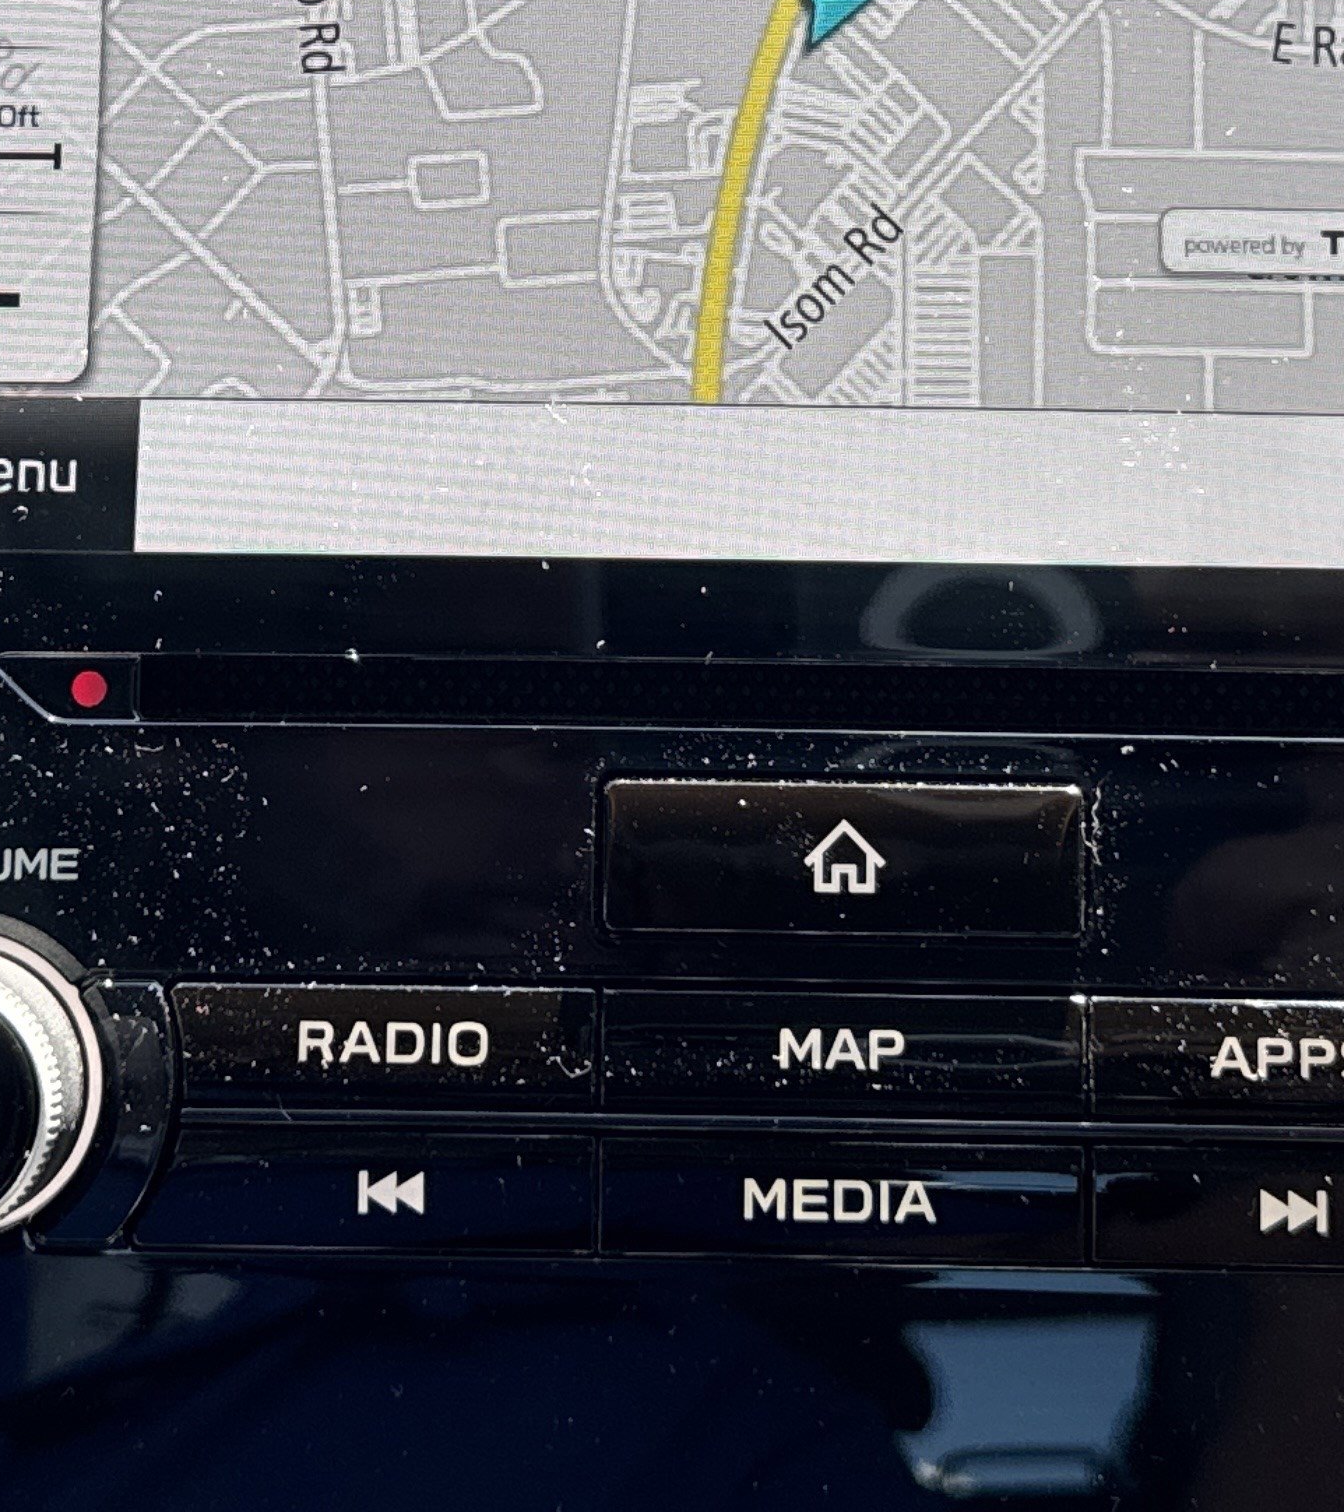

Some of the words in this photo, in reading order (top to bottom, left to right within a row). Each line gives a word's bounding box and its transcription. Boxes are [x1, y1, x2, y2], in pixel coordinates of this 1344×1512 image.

[299, 22, 347, 74] Rd
[1272, 22, 1297, 65] E
[1183, 233, 1277, 257] powered
[1280, 234, 1307, 260] by
[763, 264, 856, 350] Isom
[843, 201, 905, 266] Rd
[297, 1021, 490, 1069] RADIO
[779, 1027, 905, 1072] MAP
[743, 1177, 937, 1225] MEDIA
